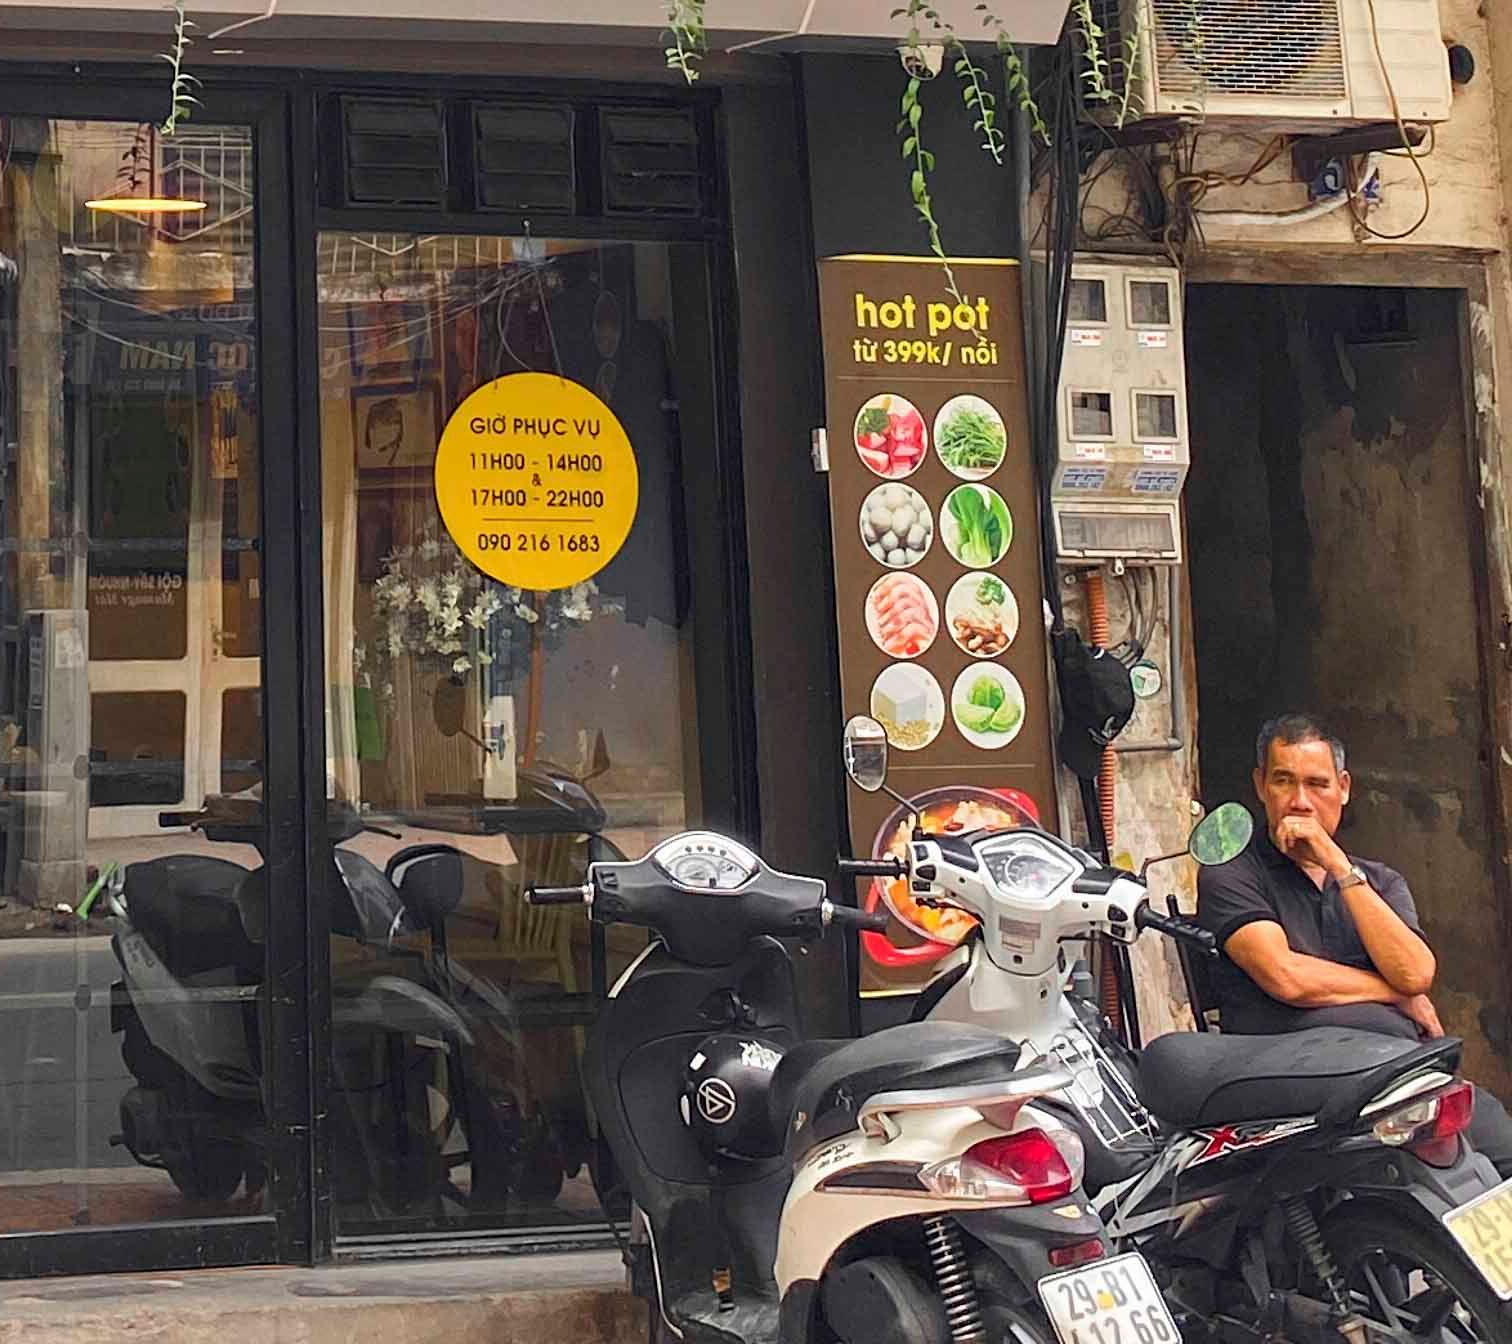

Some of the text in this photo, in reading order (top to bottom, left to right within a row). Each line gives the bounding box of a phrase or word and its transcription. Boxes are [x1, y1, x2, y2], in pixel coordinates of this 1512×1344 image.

[854, 294, 990, 337] hot pot
[853, 337, 999, 367] từ 399k/ nồi
[469, 414, 601, 441] GIỜ PHỤC VỤ
[469, 452, 603, 473] 11H00 14H00
[531, 472, 542, 488] &
[470, 489, 605, 509] 17H00 22H00
[477, 533, 601, 553] 090 216 1683
